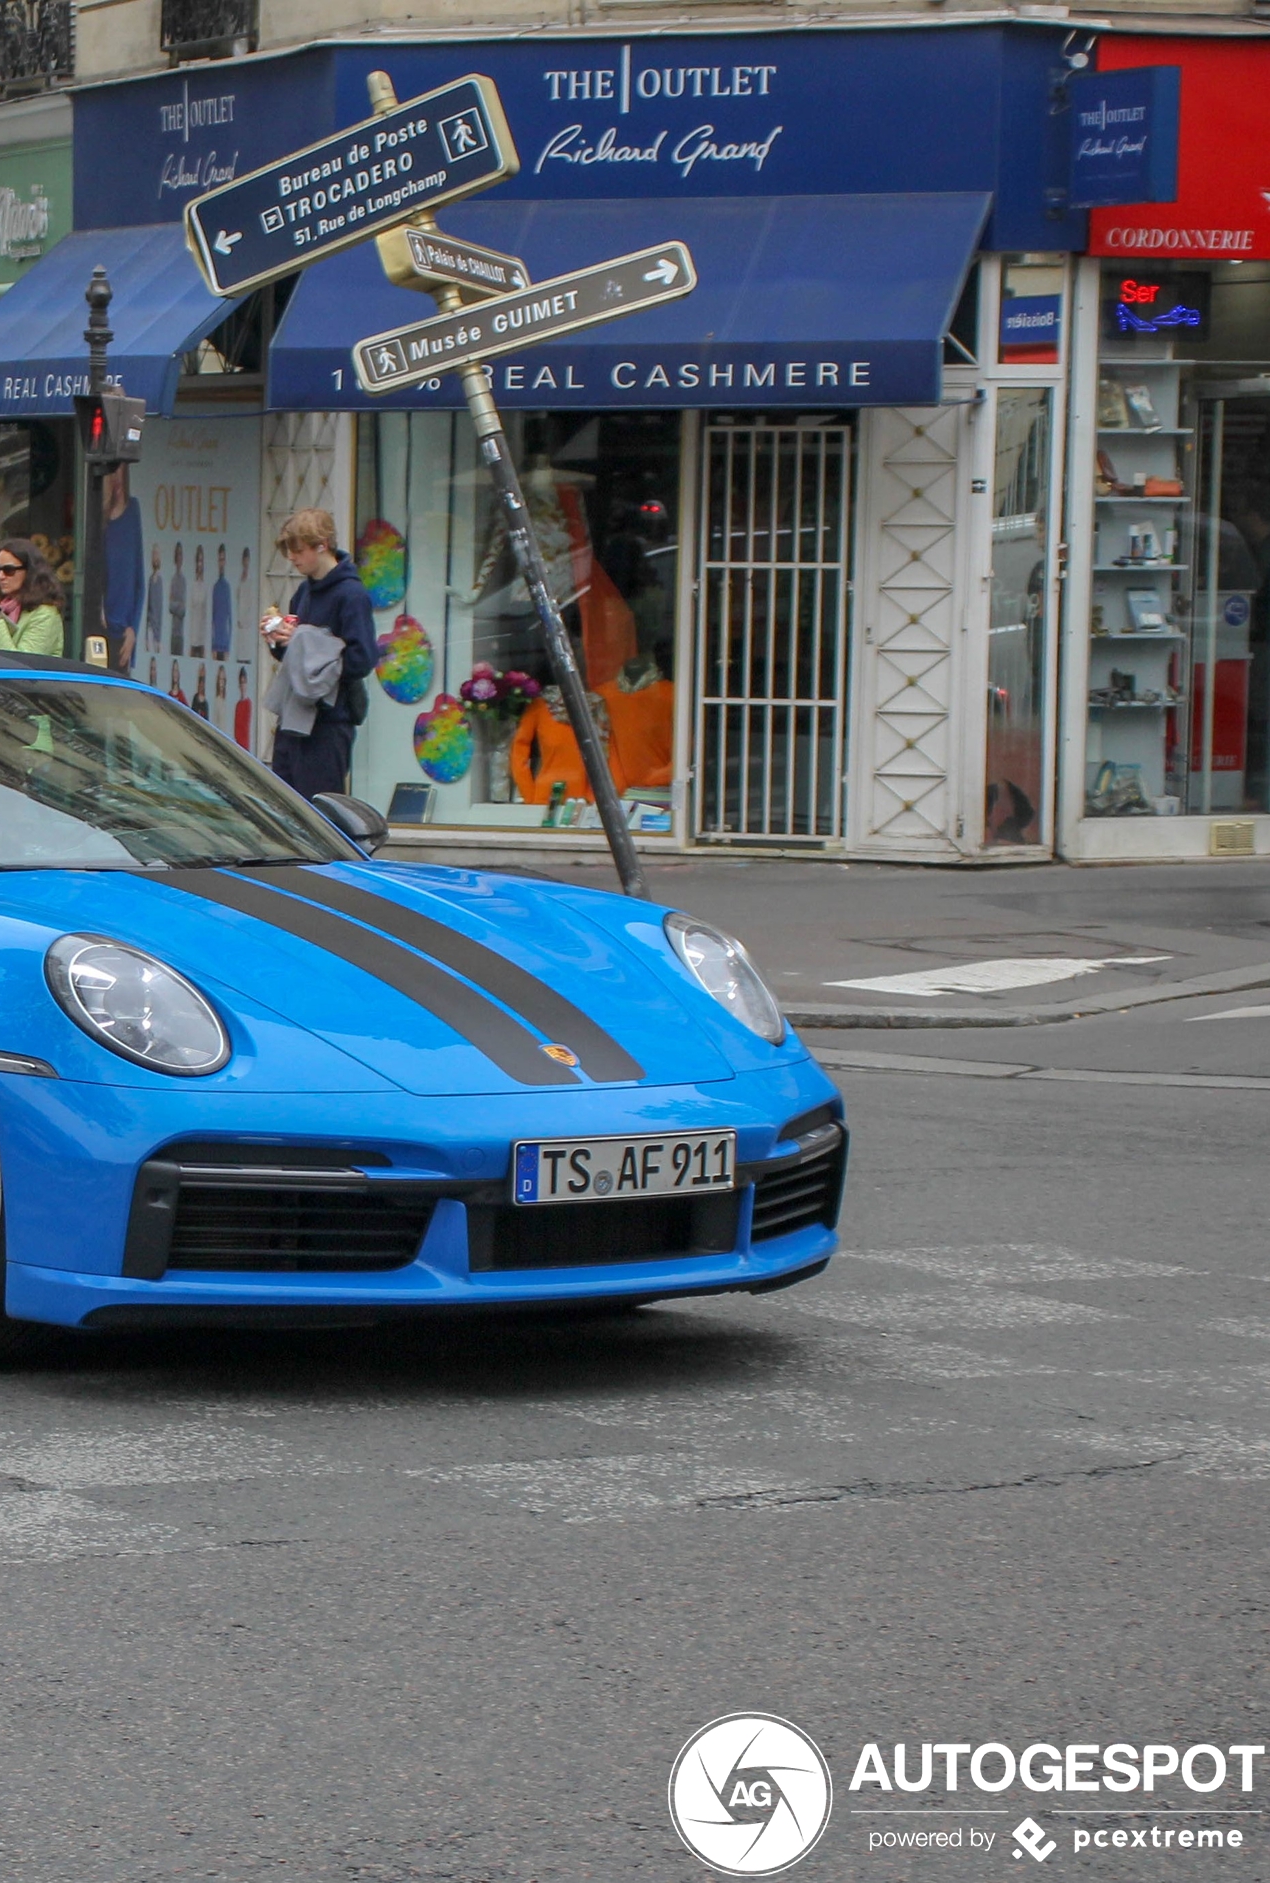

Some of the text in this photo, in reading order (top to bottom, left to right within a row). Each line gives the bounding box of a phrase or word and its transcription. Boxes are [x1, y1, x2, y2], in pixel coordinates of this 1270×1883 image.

[543, 66, 777, 100] THE OUTLET
[160, 95, 235, 132] THE OUTLET
[1079, 106, 1146, 127] THE OUTLET
[279, 118, 428, 197] Bureau de Poste
[534, 124, 783, 178] Richard Grand
[1077, 138, 1116, 161] Richard
[158, 150, 239, 199] Richard Grand
[285, 152, 414, 222] TROCADERO
[318, 214, 346, 236] Rue
[348, 204, 366, 222] de
[366, 170, 447, 214] Longchamp
[1105, 227, 1255, 250] CORDONNERIE
[427, 245, 507, 283] Palais de CHAILLOT
[1119, 278, 1160, 304] Ser
[409, 290, 579, 361] Musée GUIMET
[4, 377, 38, 399] REAL
[611, 362, 871, 388] CASHMERE
[154, 484, 233, 533] OUTLET
[523, 1138, 731, 1194] D TS AF 911
